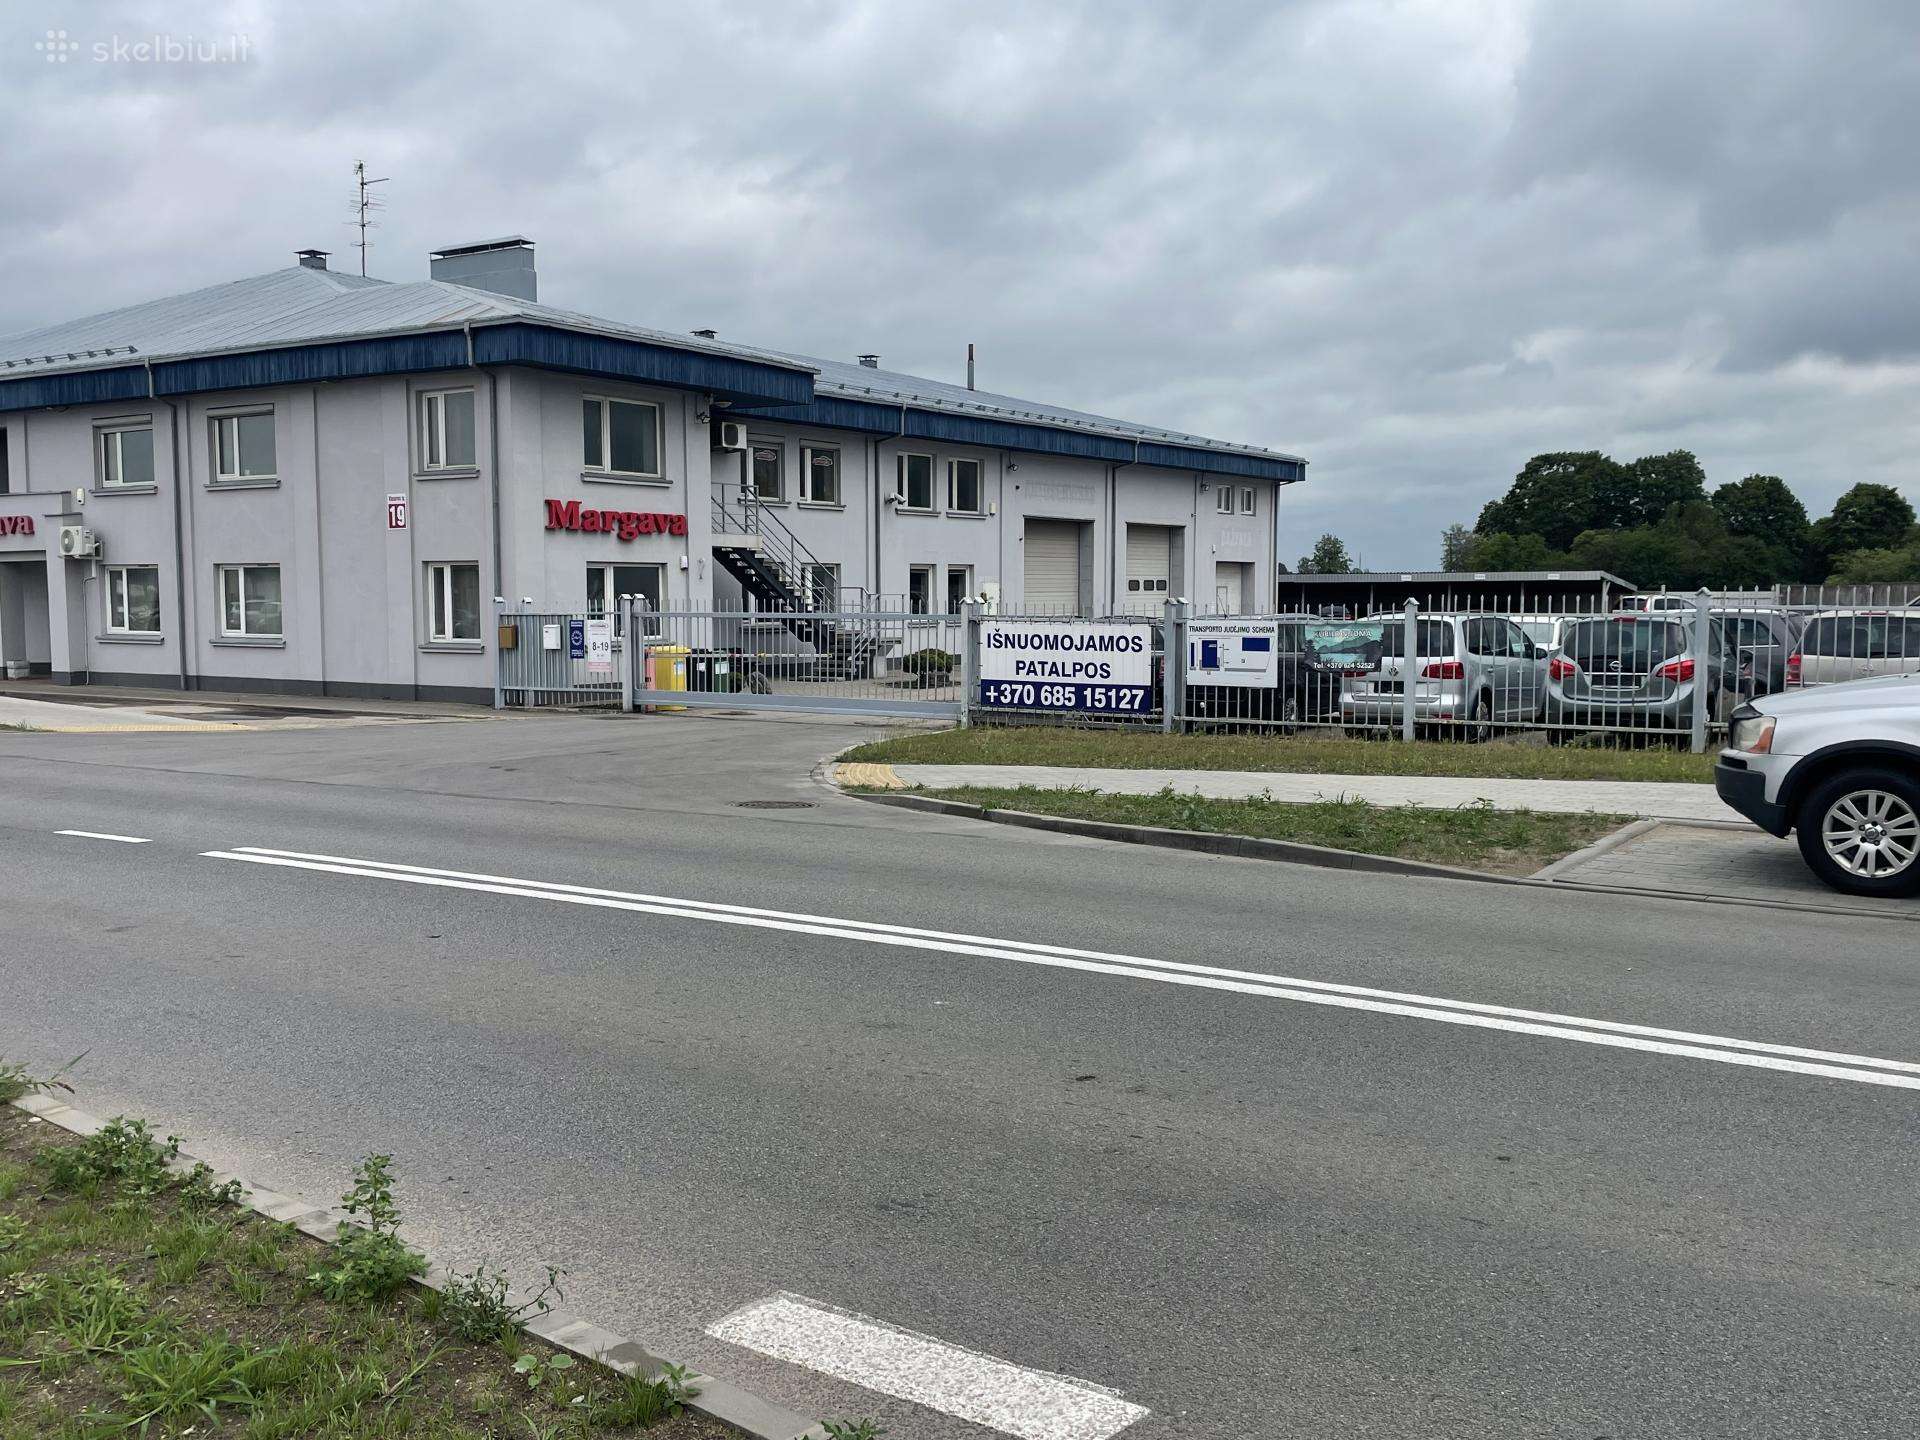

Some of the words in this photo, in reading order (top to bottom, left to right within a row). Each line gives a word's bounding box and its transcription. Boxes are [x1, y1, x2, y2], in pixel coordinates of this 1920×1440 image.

[390, 505, 405, 527] 19
[545, 499, 689, 541] Margava
[987, 628, 1143, 653] IŠNUOMOJAMOS
[1188, 625, 1223, 633] TRANSPORTO
[1252, 626, 1276, 634] SCHEMA
[1015, 660, 1111, 679] PATALPOS
[986, 684, 1035, 705] +370
[1040, 685, 1076, 707] 685
[1083, 687, 1145, 710] 15127
